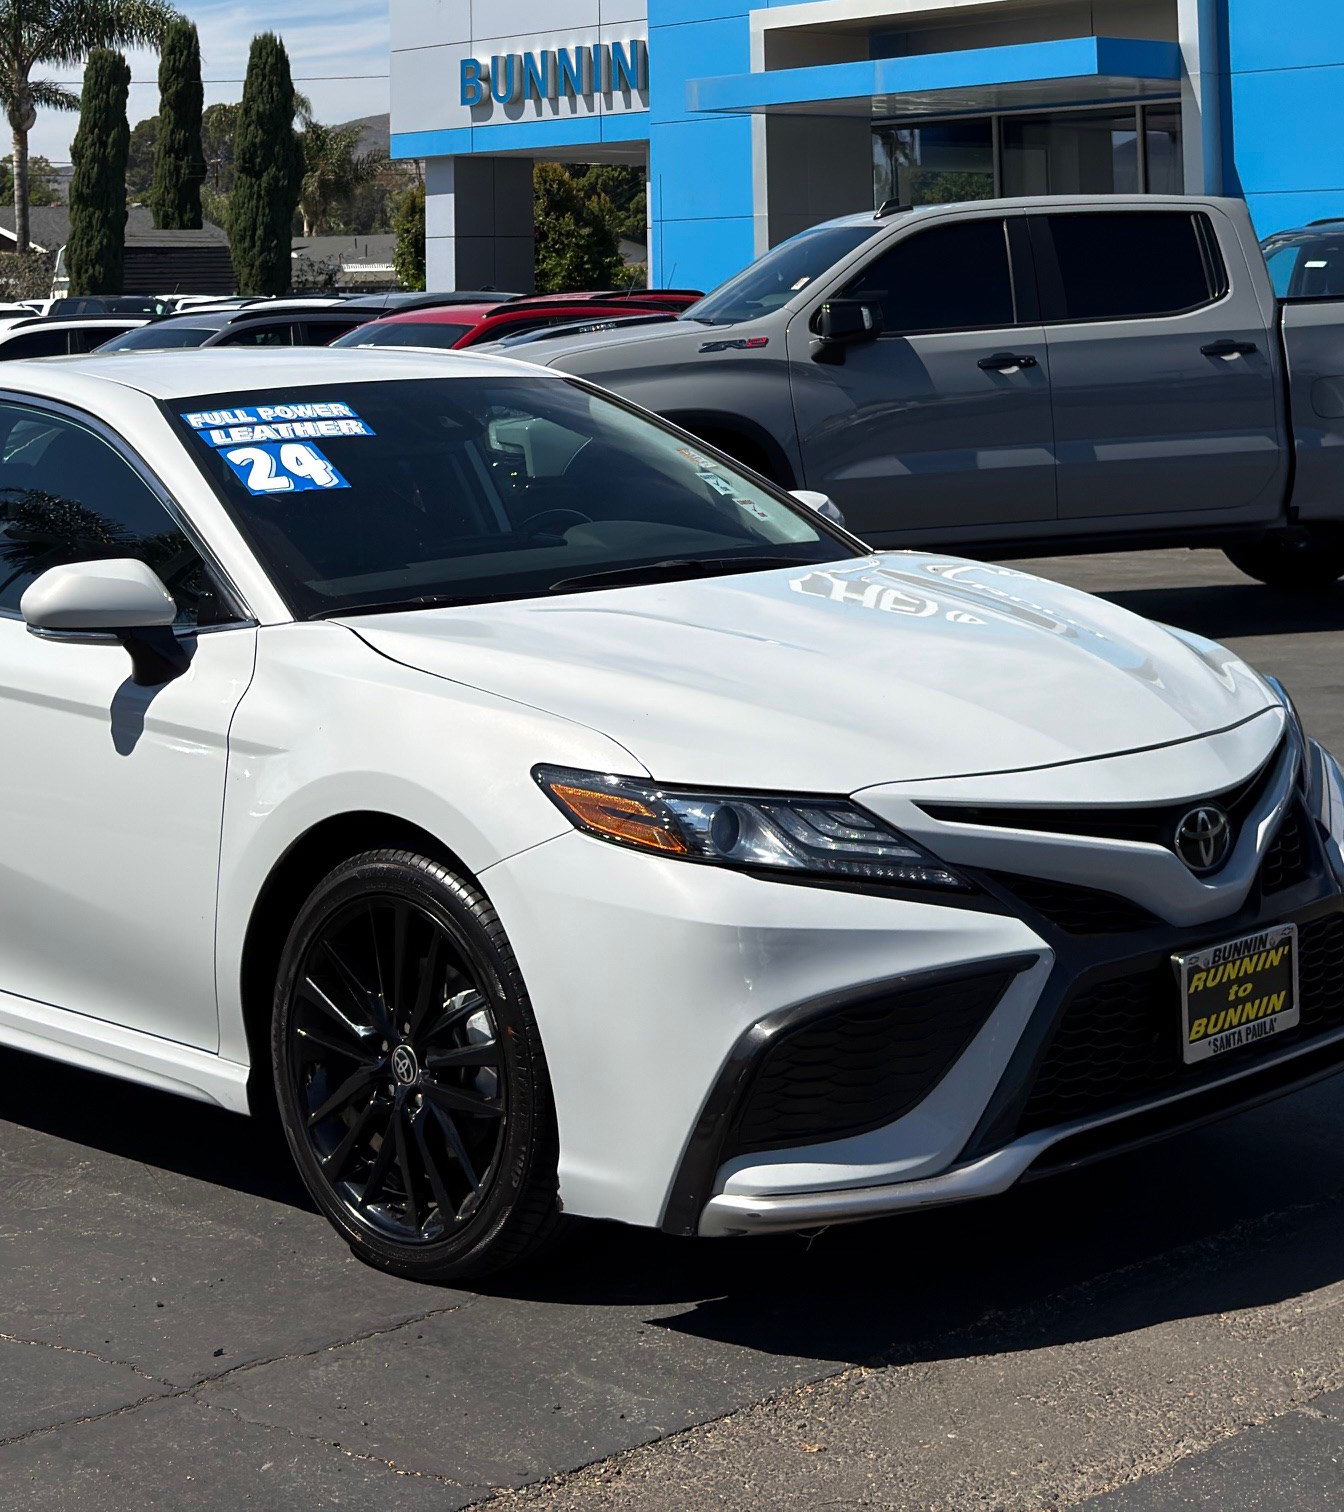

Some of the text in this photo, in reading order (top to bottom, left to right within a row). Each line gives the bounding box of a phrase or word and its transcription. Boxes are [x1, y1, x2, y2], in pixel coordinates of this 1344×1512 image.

[460, 39, 645, 107] BUNNIN
[186, 403, 352, 429] FULL POWER
[208, 419, 367, 445] LEATHER
[226, 443, 340, 492] 24
[1212, 933, 1269, 964] BUNNIN
[1188, 945, 1290, 994] RUNNIN'
[1227, 983, 1253, 1001] to
[1188, 990, 1287, 1041] BUNNIN
